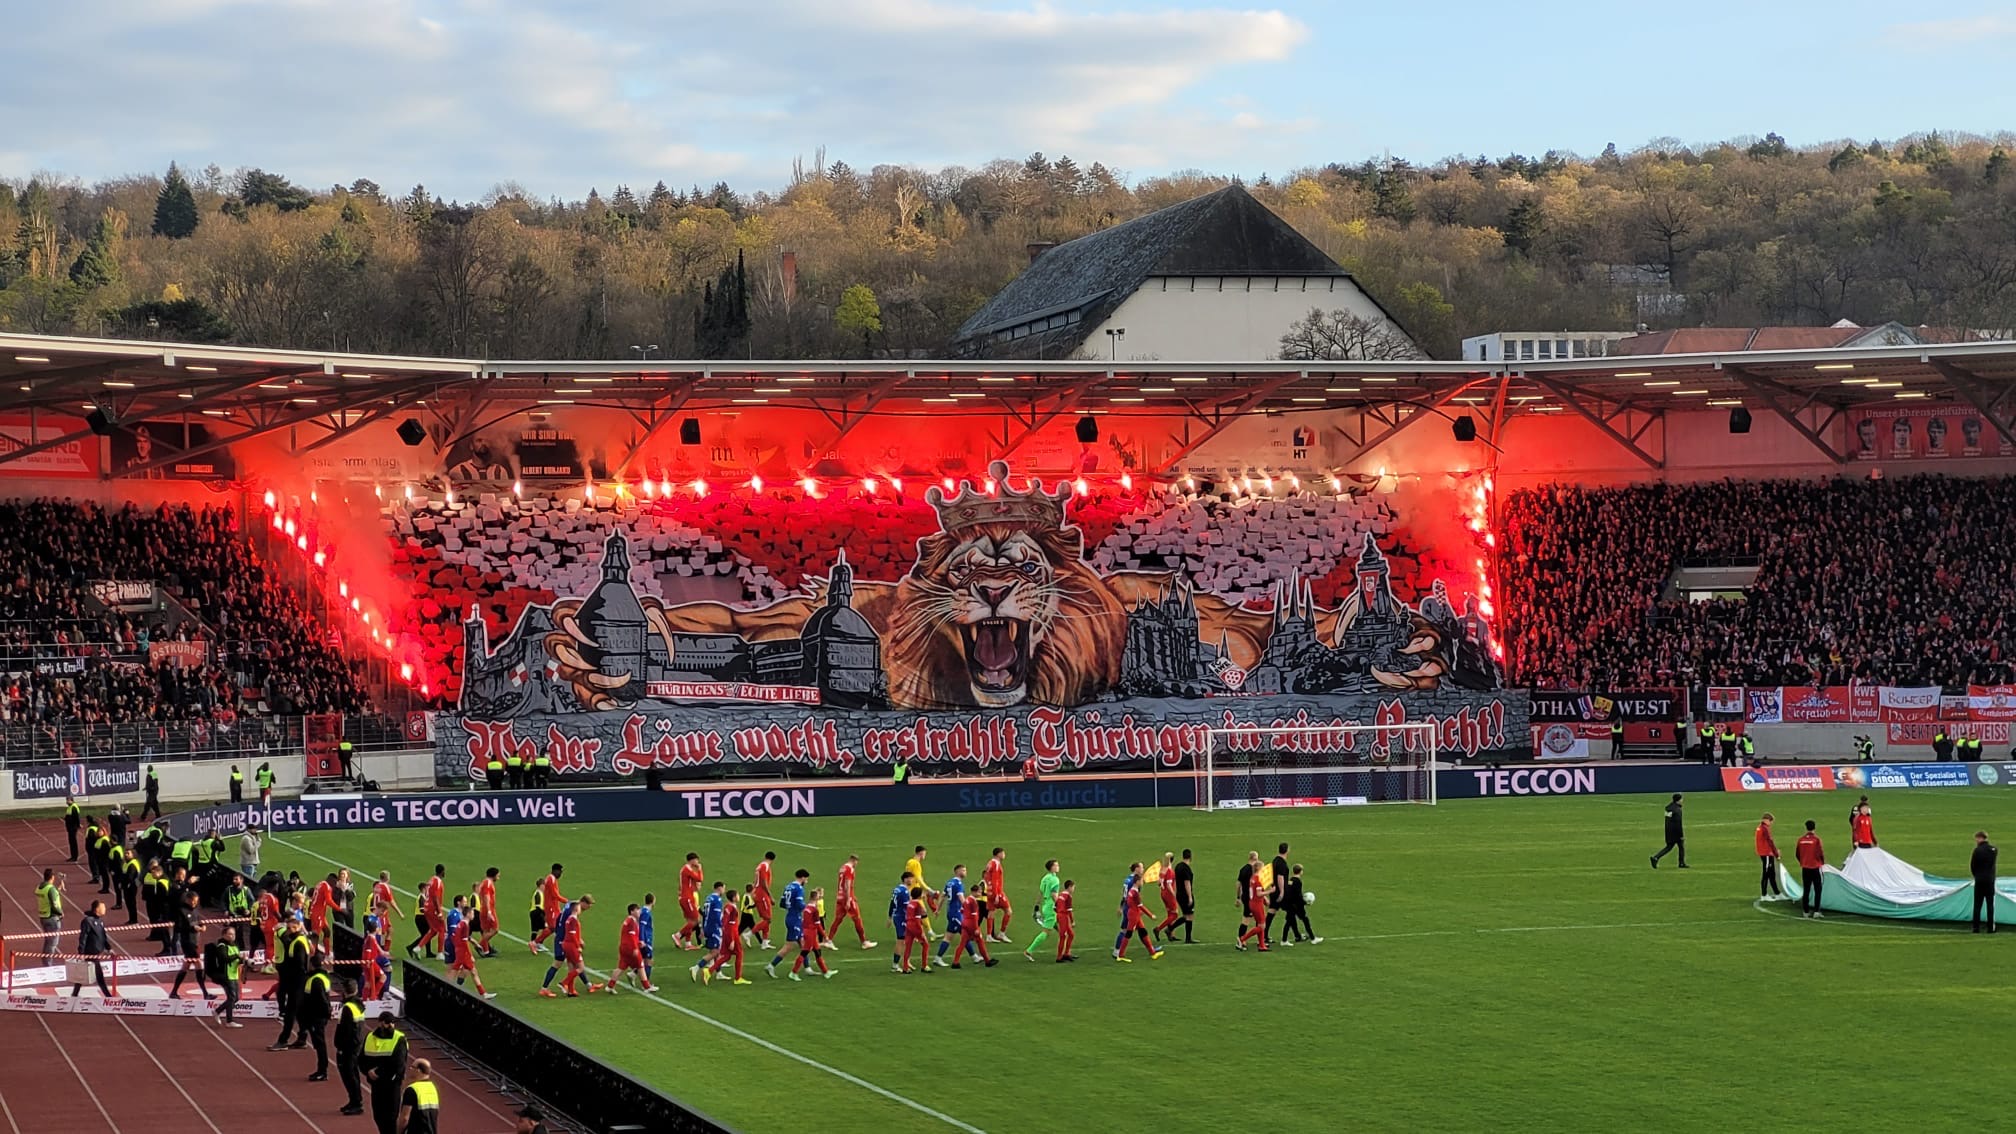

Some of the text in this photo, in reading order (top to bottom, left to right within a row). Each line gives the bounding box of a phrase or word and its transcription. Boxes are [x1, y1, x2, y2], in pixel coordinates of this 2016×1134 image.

[1866, 409, 1897, 417] Unsere
[521, 430, 536, 440] WIR
[1293, 449, 1308, 459] HT
[152, 643, 202, 660] OSTKURVE
[740, 685, 778, 700] ECHTE
[782, 687, 819, 701] LIEBE
[1854, 686, 1876, 697] RWE
[1616, 699, 1671, 715] WEST
[1857, 698, 1872, 707] Fans
[1851, 707, 1878, 719] Apolda
[547, 722, 602, 776] der
[611, 713, 725, 777] Löwe
[730, 715, 856, 774] wacht,
[861, 714, 1020, 770] erstrahlt
[1027, 705, 1215, 773] Thüringen
[1222, 707, 1263, 754] in
[1269, 708, 1362, 755] seiner
[1369, 697, 1506, 763] Pracht!
[1904, 724, 1946, 740] SEKTOR
[15, 767, 138, 794] Brigade Weimar
[1474, 768, 1596, 796] TECCON
[1910, 772, 1924, 780] Der
[1925, 770, 1957, 780] Spezialist
[681, 789, 815, 818] TECCON
[959, 784, 1117, 809] Starte durch:
[193, 811, 211, 835] Dein
[211, 804, 309, 836] Sprungbrett
[315, 803, 339, 824] in
[346, 801, 386, 823] die
[391, 799, 500, 821] TECCON
[516, 795, 576, 818] Welt
[7, 994, 48, 1005] NextPhones
[102, 998, 148, 1008] NextPhones
